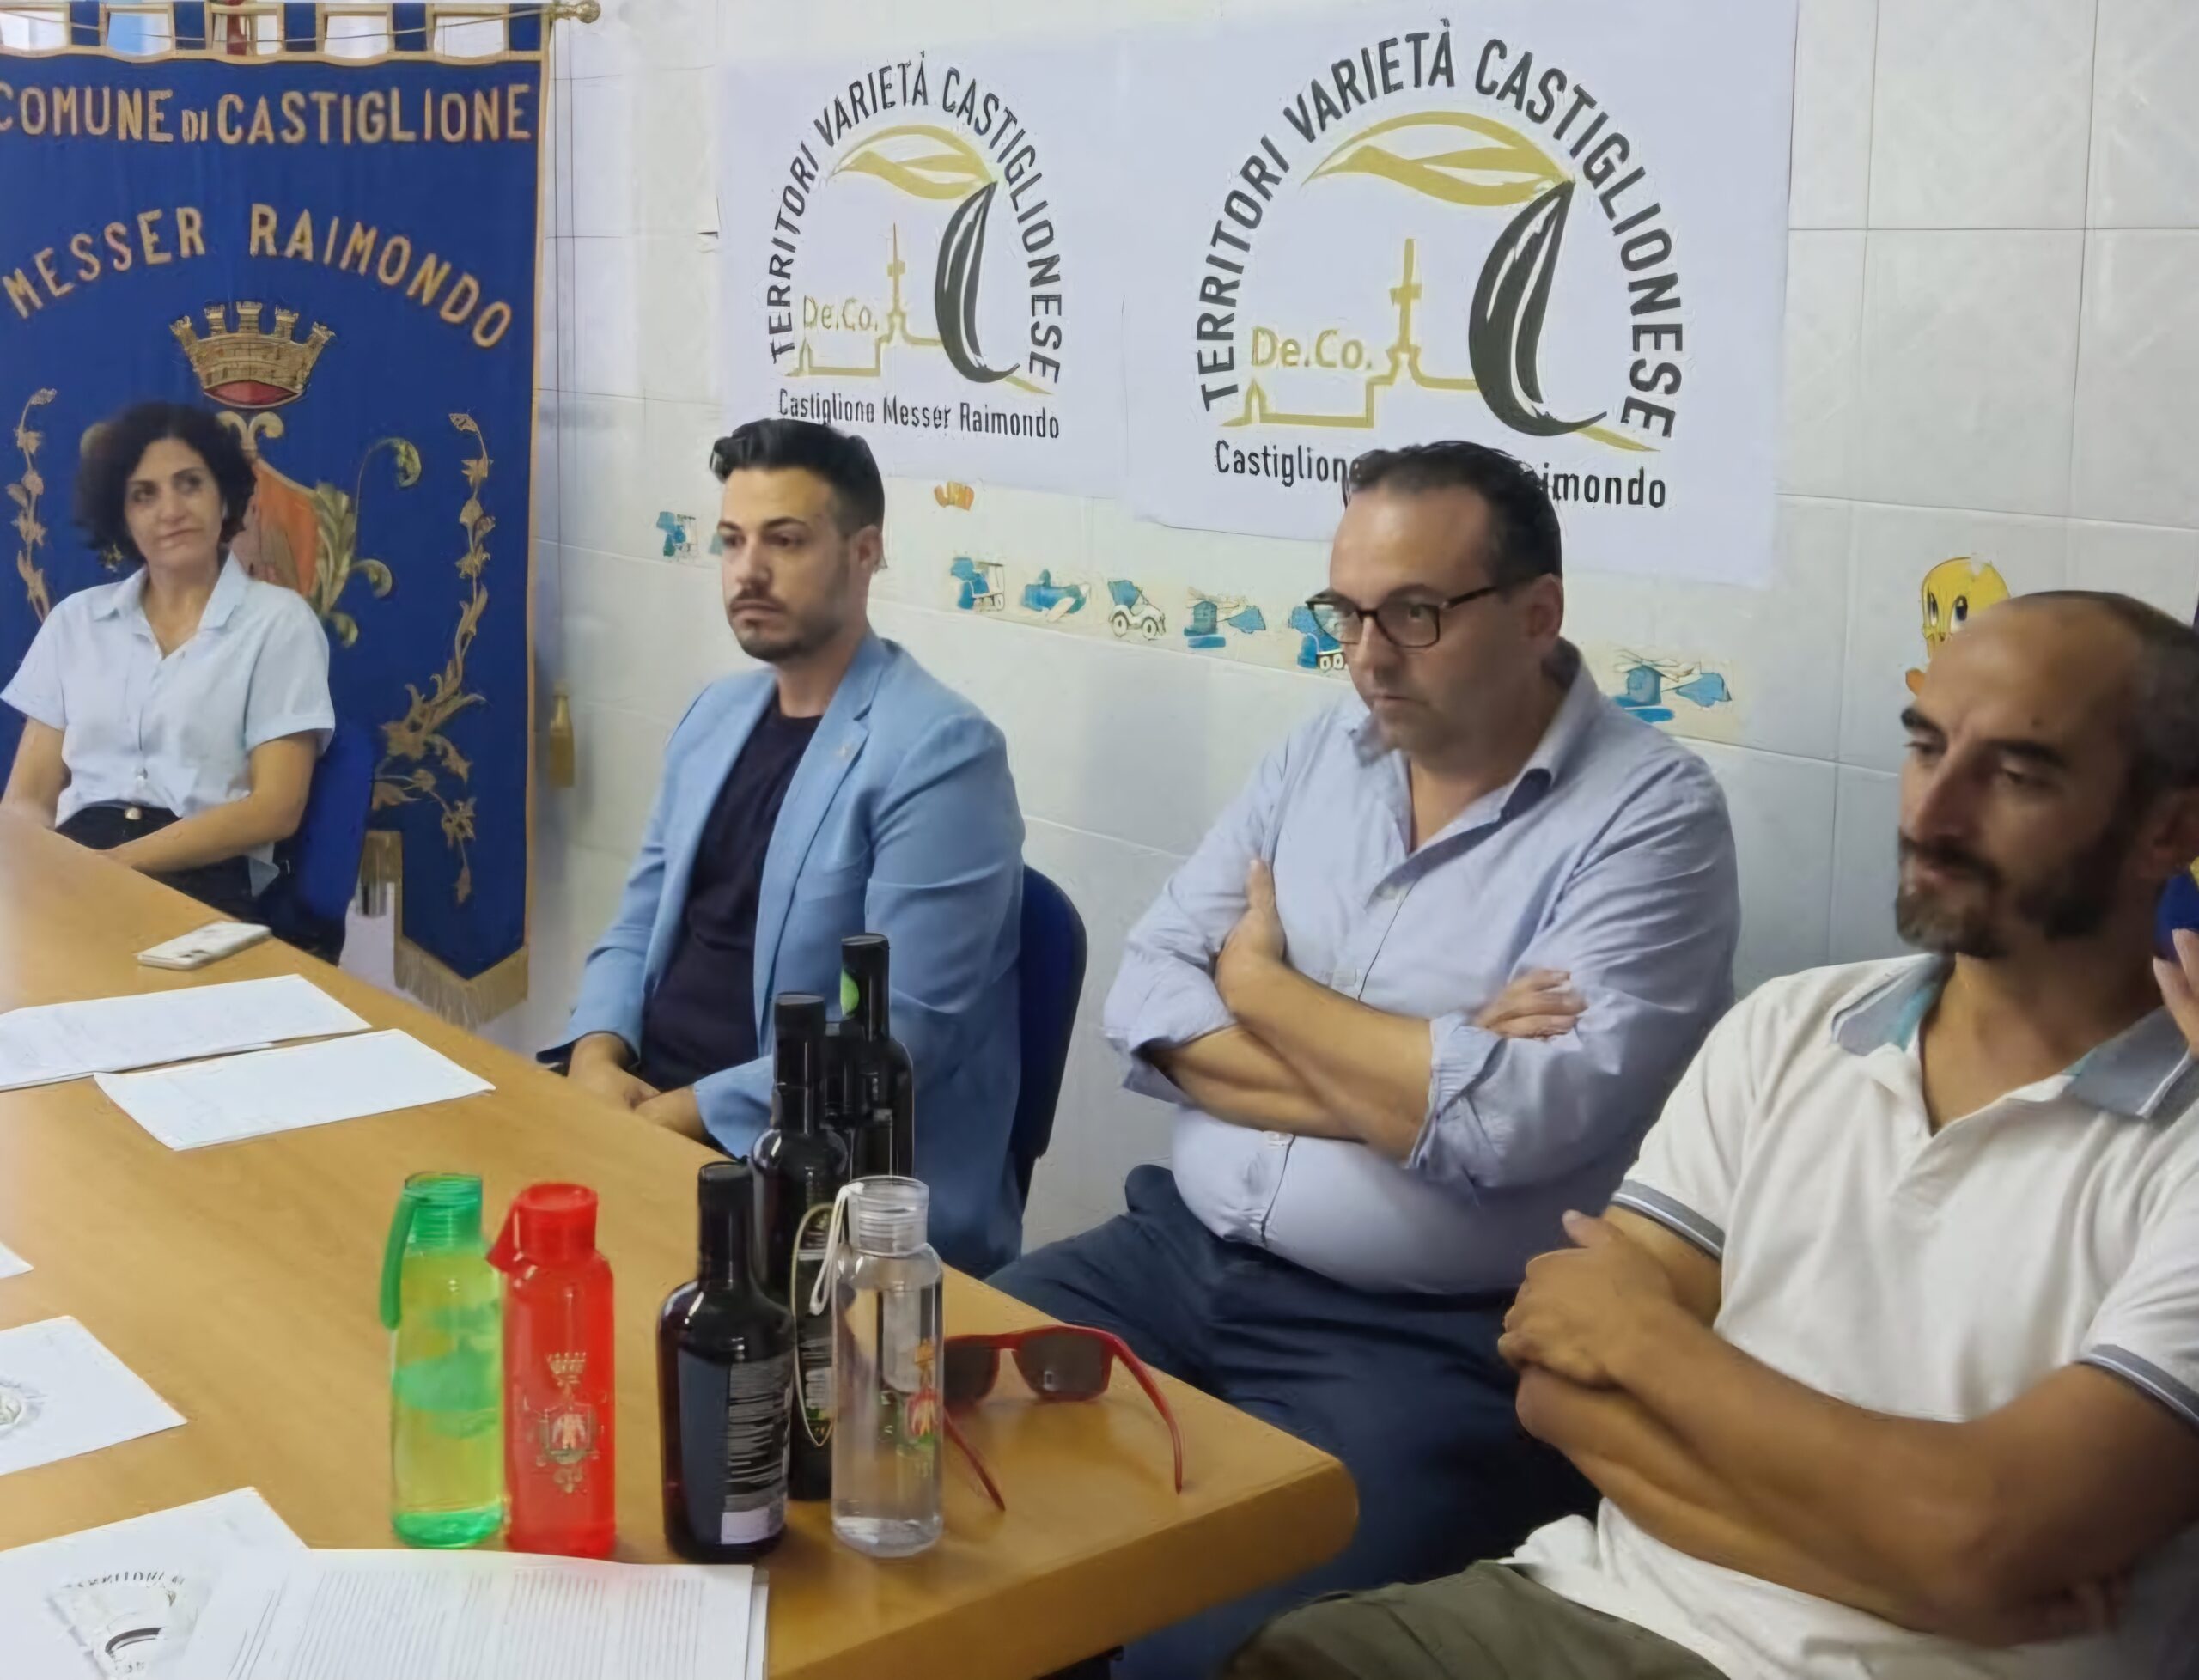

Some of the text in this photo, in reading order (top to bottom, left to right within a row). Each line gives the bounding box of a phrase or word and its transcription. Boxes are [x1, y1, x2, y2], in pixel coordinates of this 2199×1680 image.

[0, 81, 532, 145] COMUNE DI CASTIGLIONE
[766, 50, 1063, 385] TERRITORI VARIETÀ CASTIGLIONESE
[1197, 17, 1684, 439] TERRITORI VARIETÀ CASTIGLIONESE
[2, 203, 513, 349] MESSER RAIMONDO
[802, 295, 879, 332] De.Co.
[1250, 325, 1373, 370] De.Co.
[779, 387, 1060, 439] Castiglione Messer Raimondo
[1215, 439, 1348, 488] Castiglion
